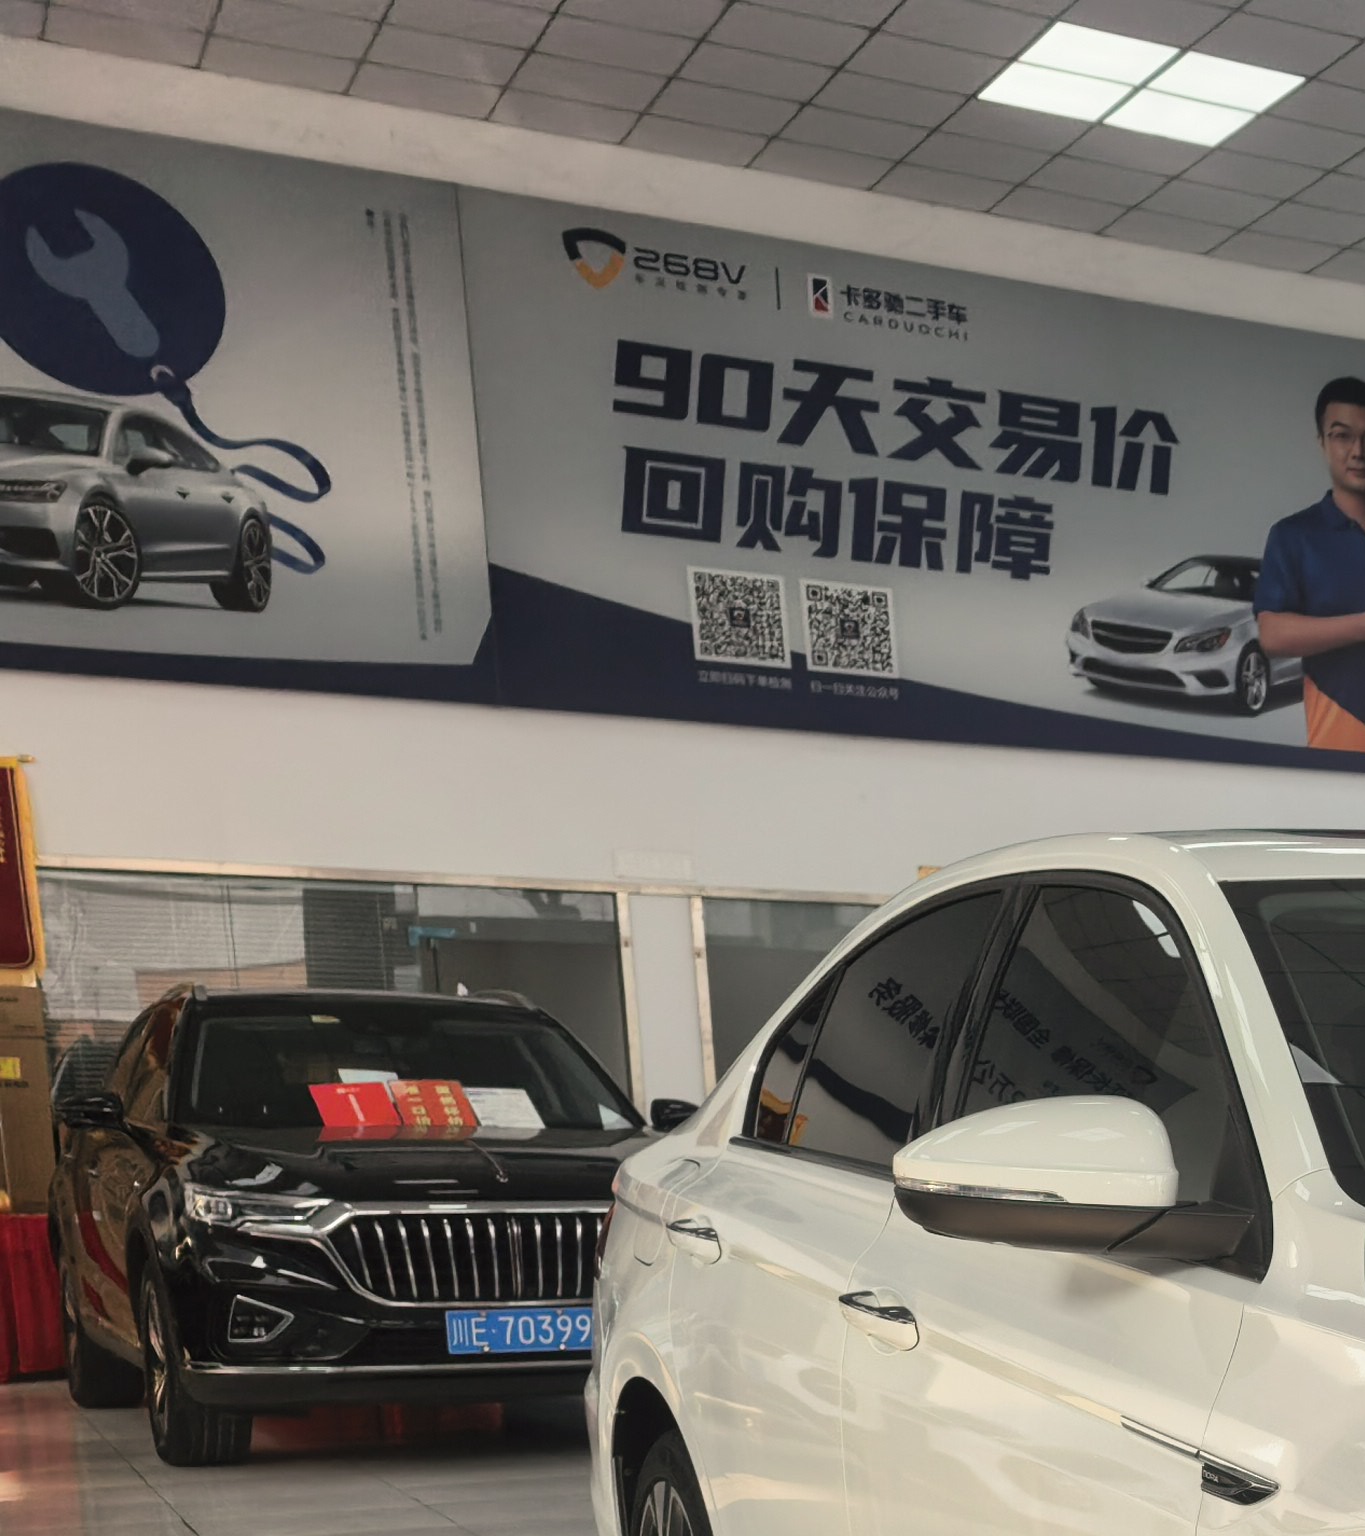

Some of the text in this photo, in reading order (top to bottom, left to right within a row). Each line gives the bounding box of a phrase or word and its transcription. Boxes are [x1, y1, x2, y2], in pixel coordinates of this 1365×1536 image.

[633, 247, 746, 284] 268V
[840, 284, 968, 324] 卡多驰二手车
[612, 339, 1180, 496] 90天交易价
[621, 446, 1056, 581] 回购保障
